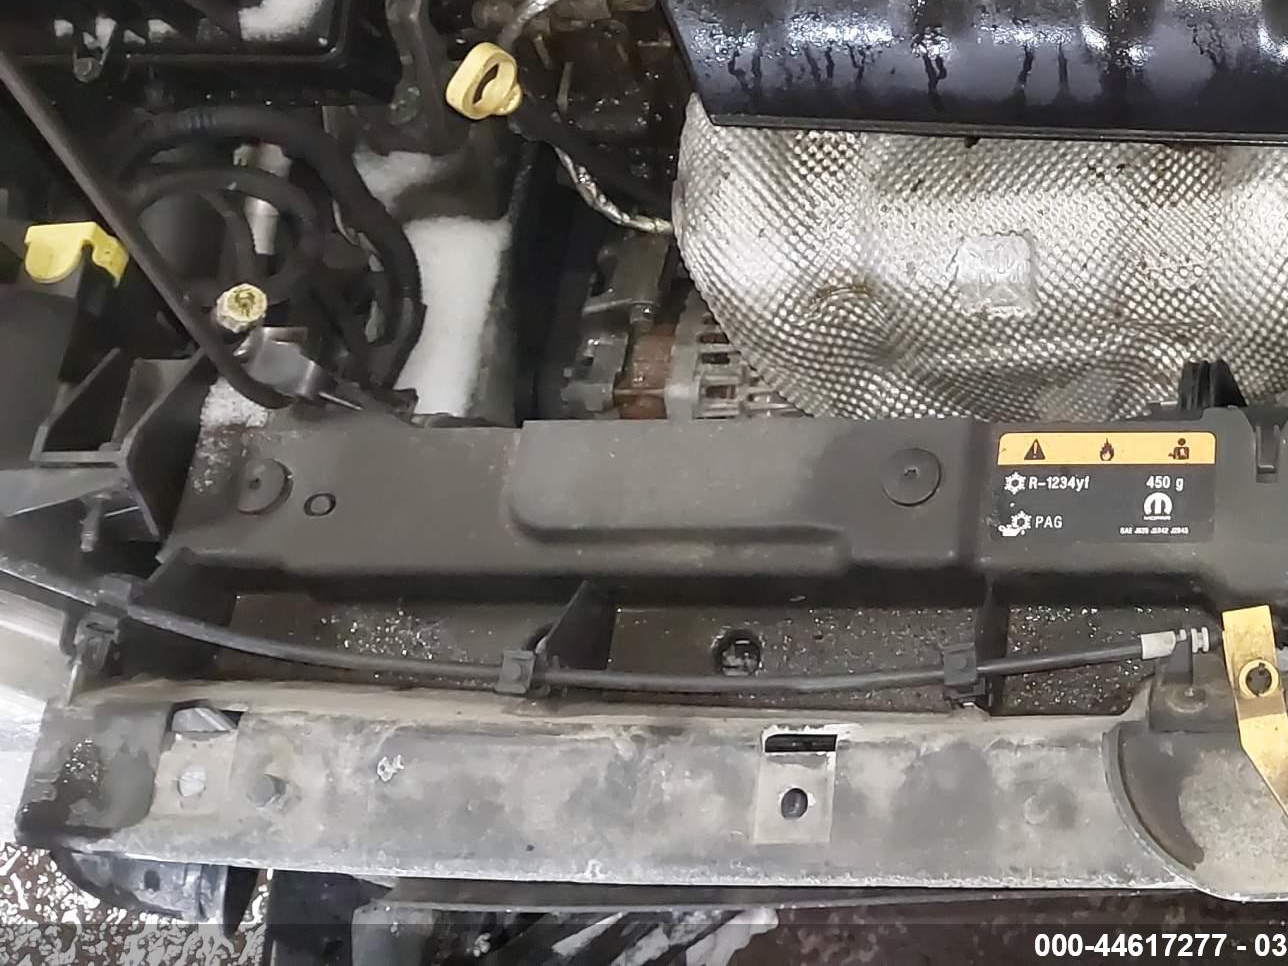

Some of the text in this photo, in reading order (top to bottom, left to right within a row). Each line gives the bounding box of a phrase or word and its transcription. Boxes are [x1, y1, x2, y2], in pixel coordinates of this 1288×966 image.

[1028, 475, 1090, 492] R-1234yf
[1146, 475, 1184, 492] 450 g
[1035, 515, 1063, 529] PAG
